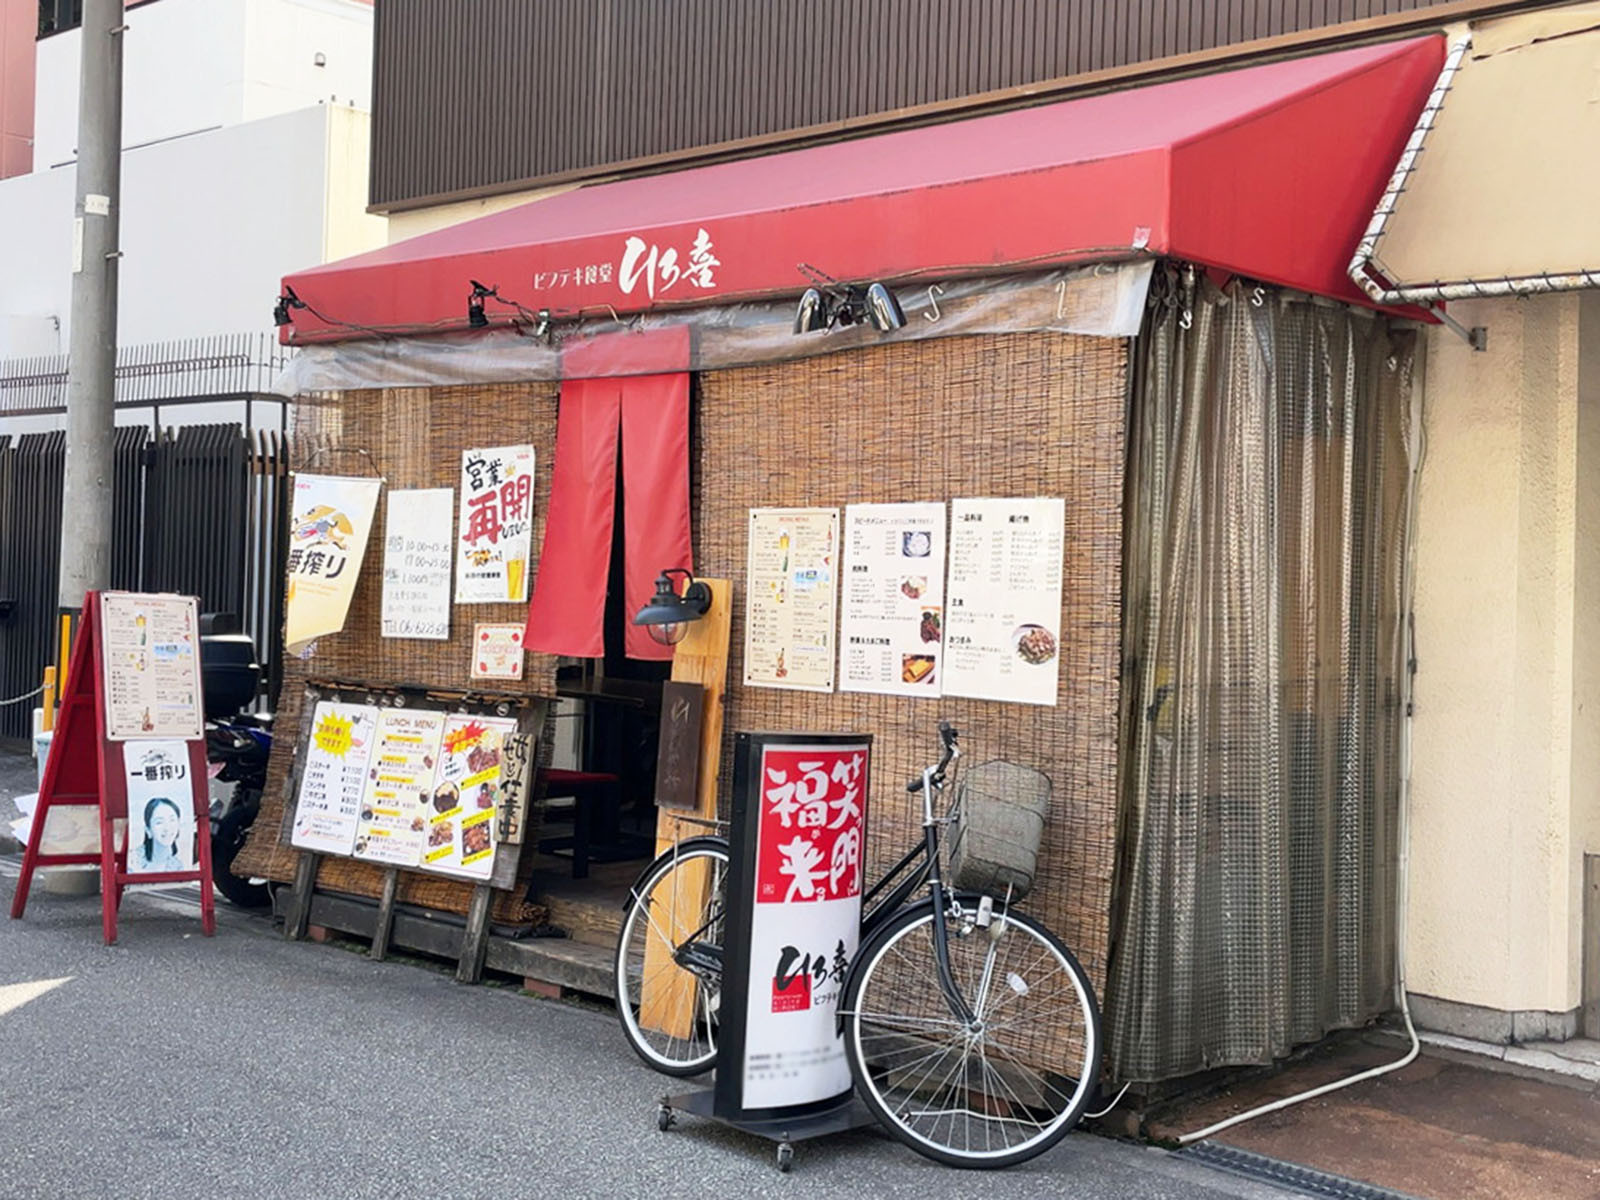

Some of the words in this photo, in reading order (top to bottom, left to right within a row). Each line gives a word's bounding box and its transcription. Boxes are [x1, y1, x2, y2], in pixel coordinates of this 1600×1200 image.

[464, 452, 503, 492] 営業
[462, 474, 532, 547] 再開
[414, 720, 437, 730] MENU
[130, 764, 186, 782] 一番搾り
